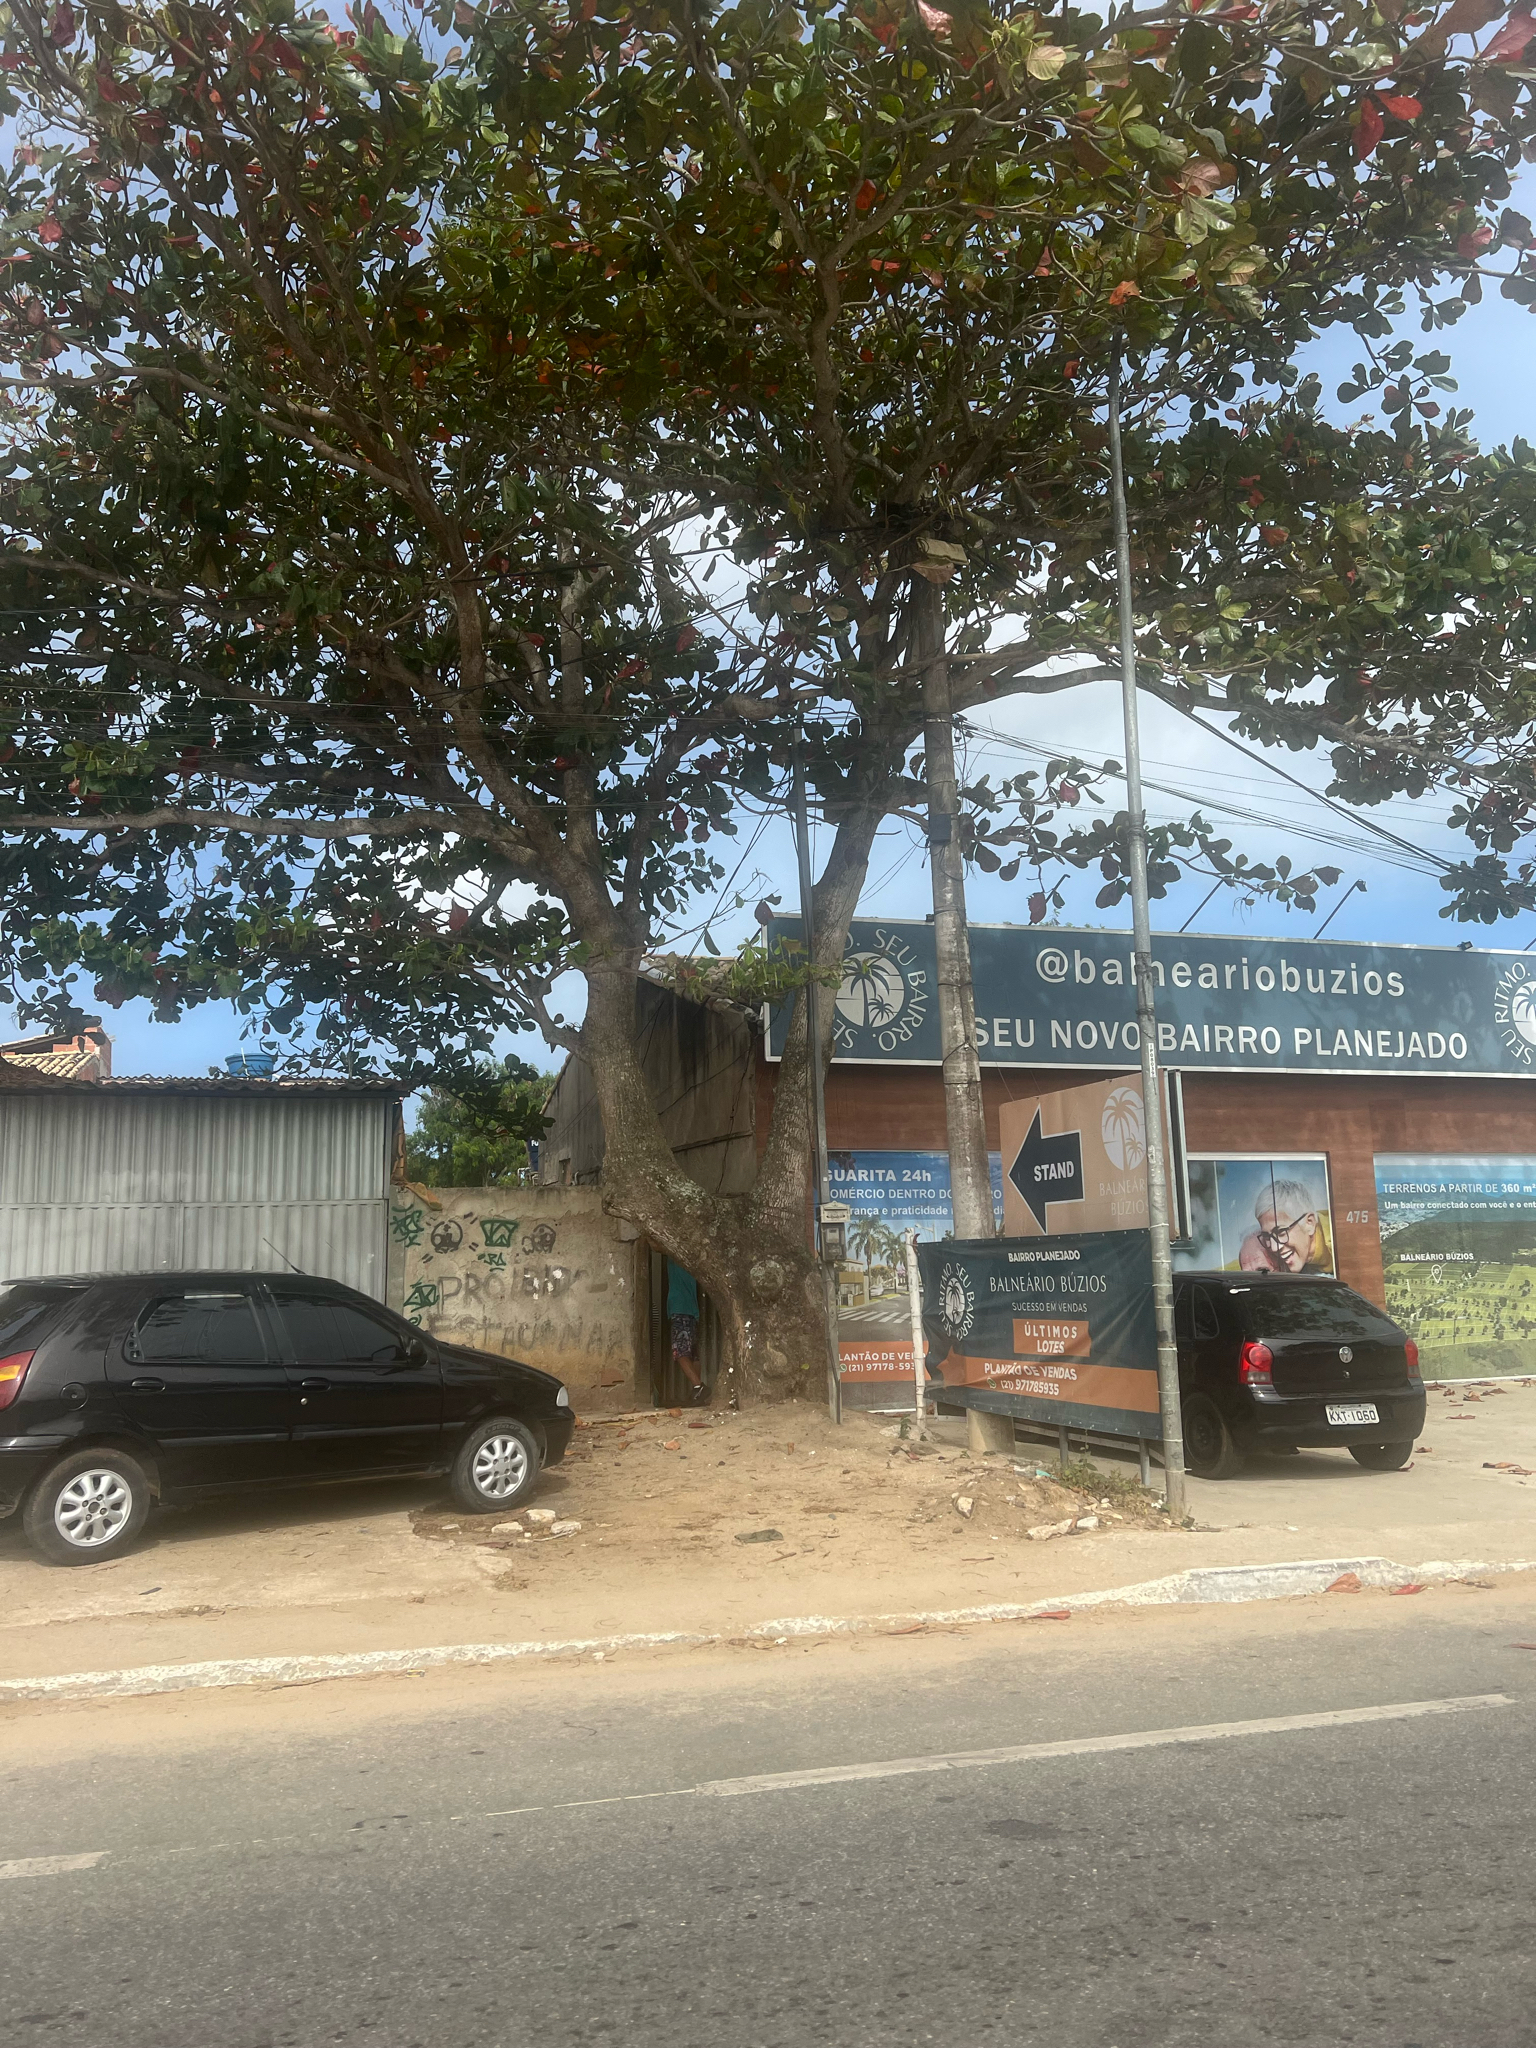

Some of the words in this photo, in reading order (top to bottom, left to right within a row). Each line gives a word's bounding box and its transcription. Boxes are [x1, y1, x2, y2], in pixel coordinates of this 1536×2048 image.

[873, 928, 917, 966] SEU
[1036, 947, 1405, 997] @balneariobuzios
[974, 1017, 1034, 1048] SEU
[1051, 1020, 1141, 1051] NOVO
[1158, 1023, 1281, 1055] BAIRRO
[1294, 1028, 1467, 1060] PLANEJADO
[1501, 1029, 1534, 1065] SEU
[902, 1169, 932, 1182] 24h
[1034, 1161, 1074, 1181] STAND
[830, 1187, 885, 1199] OMÉRCIO
[888, 1189, 936, 1199] DENTRO
[1383, 1183, 1437, 1194] TERRENOS
[1439, 1184, 1447, 1193] A
[1449, 1183, 1483, 1193] PARTIR
[1485, 1183, 1499, 1193] DE
[1501, 1183, 1520, 1193] 360
[893, 1205, 948, 1217] praticidade
[1384, 1201, 1399, 1209] Um
[1400, 1201, 1425, 1209] bairro
[1427, 1201, 1469, 1209] conectado
[1489, 1200, 1508, 1209] você
[1346, 1210, 1369, 1224] 475
[1008, 1252, 1035, 1262] BAIRRO
[1036, 1250, 1081, 1261] PLANEJADO
[1400, 1252, 1444, 1261] BALNEÁRIO
[1446, 1251, 1474, 1260] BÚZIOS
[956, 1263, 971, 1288] SEU
[990, 1272, 1055, 1292] BALNEÁRIO
[1060, 1271, 1107, 1293] BÚZIOS
[1011, 1302, 1044, 1311] SUCESSO
[1046, 1302, 1057, 1312] EM
[1058, 1303, 1088, 1313] VENDAS
[1024, 1321, 1077, 1339] ÚLTIMOS
[1037, 1340, 1065, 1353] LOTES
[838, 1351, 879, 1361] LANTÃO
[881, 1352, 895, 1361] DE
[848, 1364, 864, 1373] (21)
[866, 1362, 915, 1371] 97178-593
[984, 1362, 1022, 1375] PLANTÃO
[1023, 1365, 1040, 1377] DE
[1040, 1366, 1078, 1380] VENDAS
[1000, 1380, 1014, 1391] (21)
[1015, 1379, 1060, 1396] 971785935
